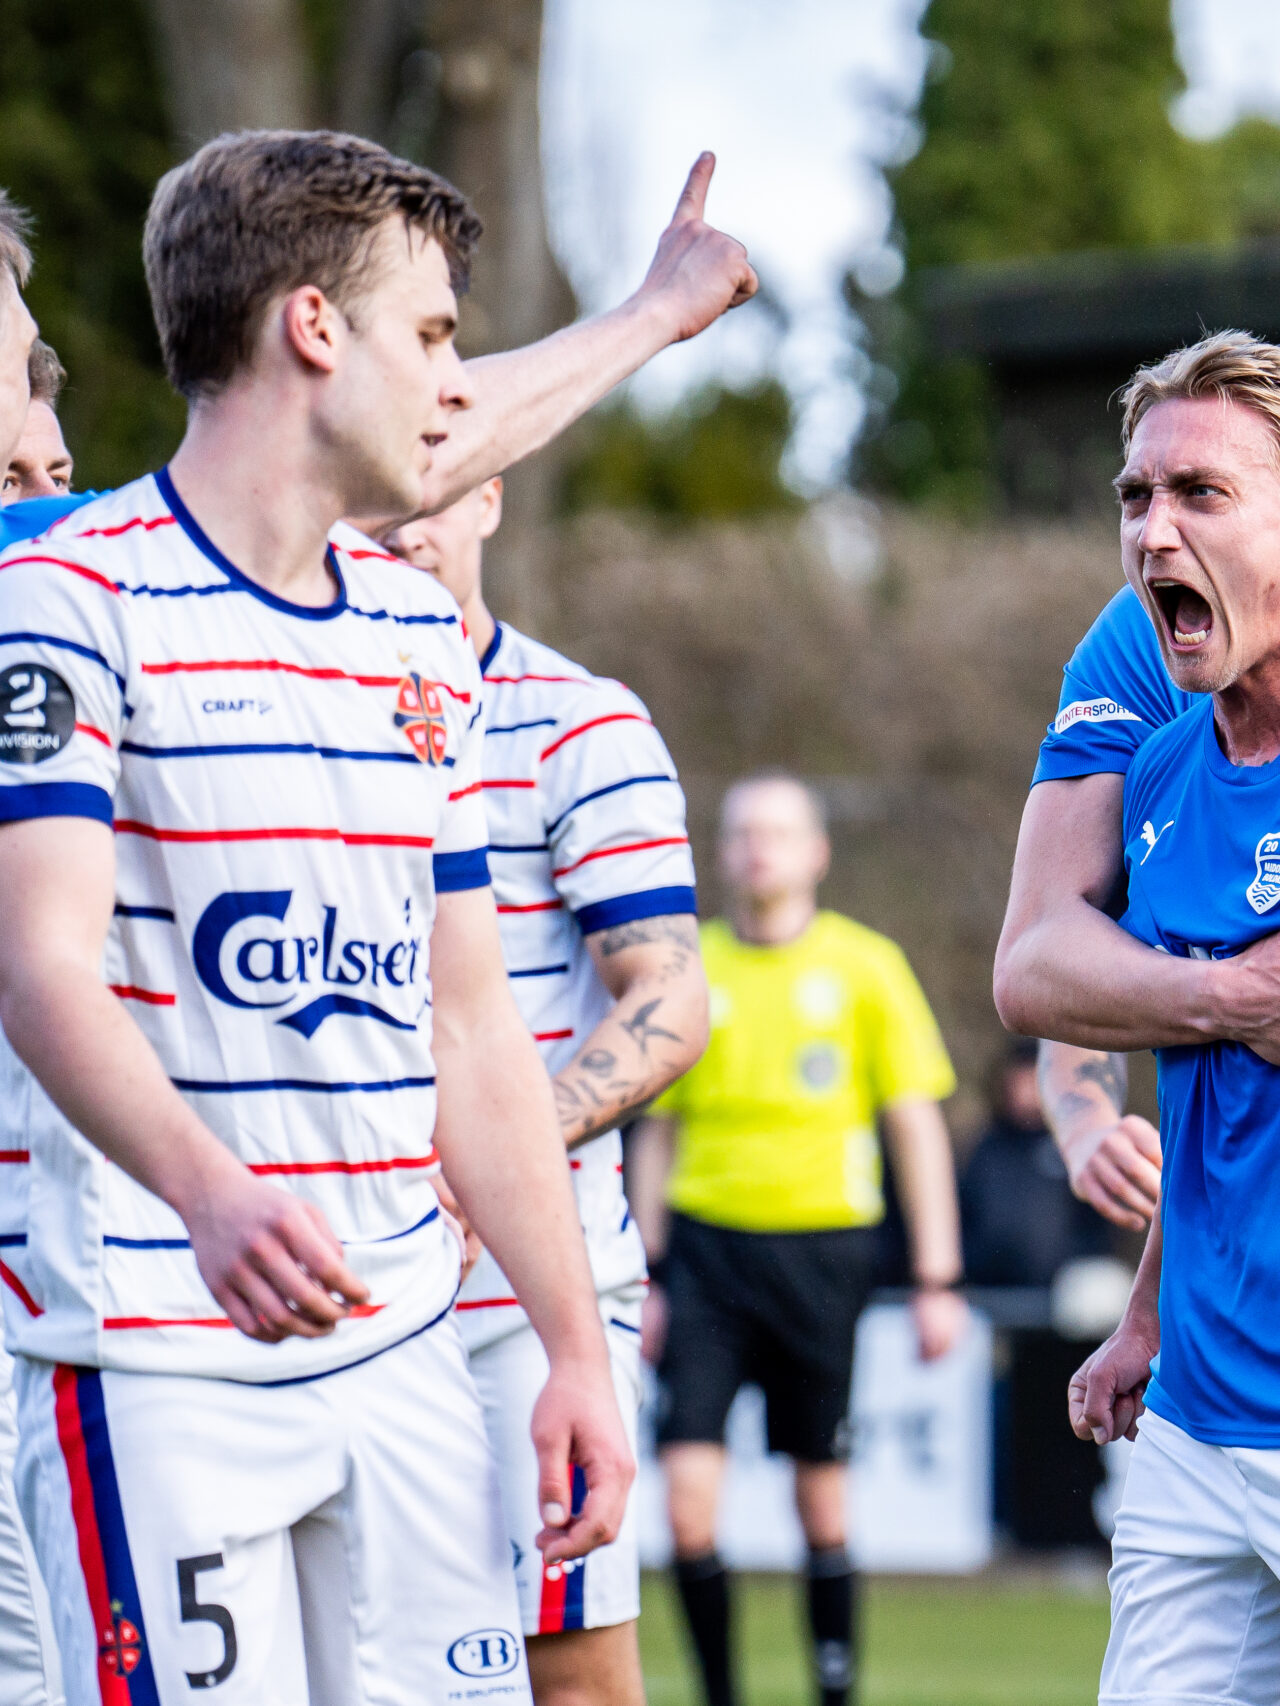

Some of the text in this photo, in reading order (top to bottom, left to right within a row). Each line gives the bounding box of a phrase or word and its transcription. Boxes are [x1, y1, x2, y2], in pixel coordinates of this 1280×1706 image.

[3, 672, 47, 727] 2
[1062, 703, 1132, 725] INTERSPOR
[0, 733, 60, 750] IVISION
[1263, 841, 1279, 853] 20
[176, 1552, 238, 1690] 5
